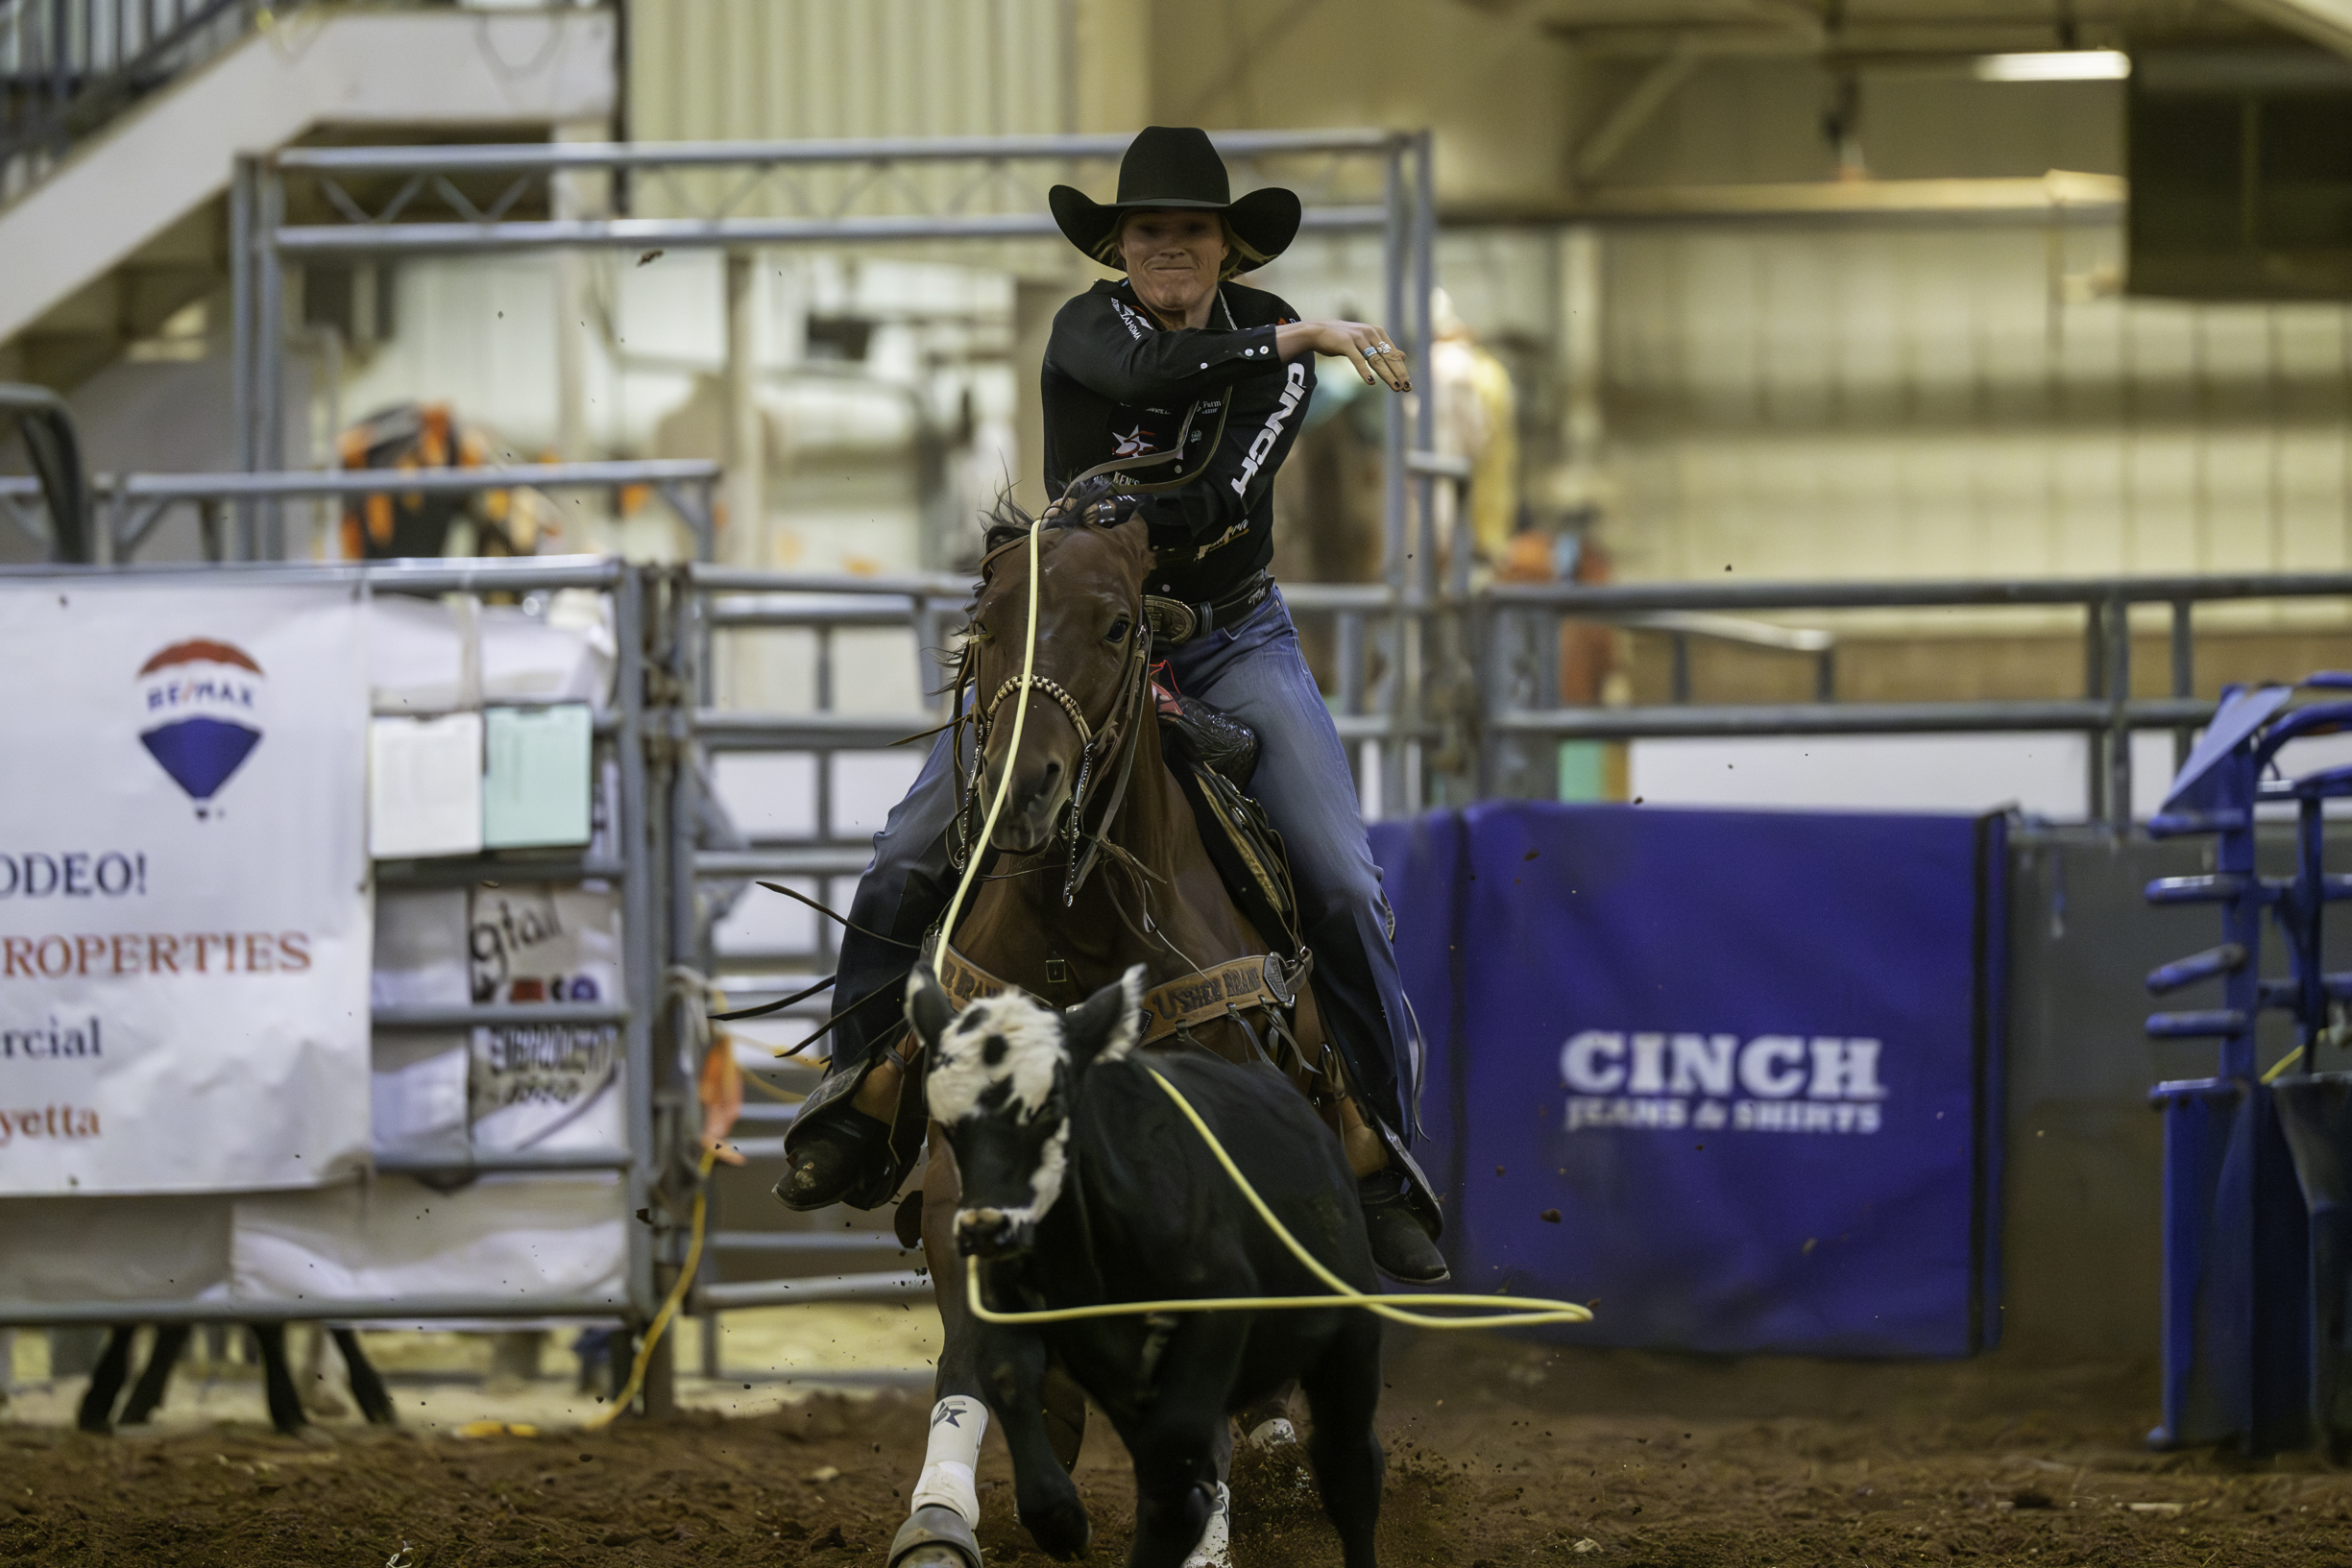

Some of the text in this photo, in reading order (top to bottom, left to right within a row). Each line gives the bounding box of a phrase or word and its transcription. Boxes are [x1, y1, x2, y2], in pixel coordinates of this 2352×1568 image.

[2, 929, 312, 978] ROPERTIES
[2, 1014, 102, 1059] rcial
[1560, 1029, 1886, 1099] CINCH
[1564, 1097, 1880, 1134] JEANS & SHIRTS
